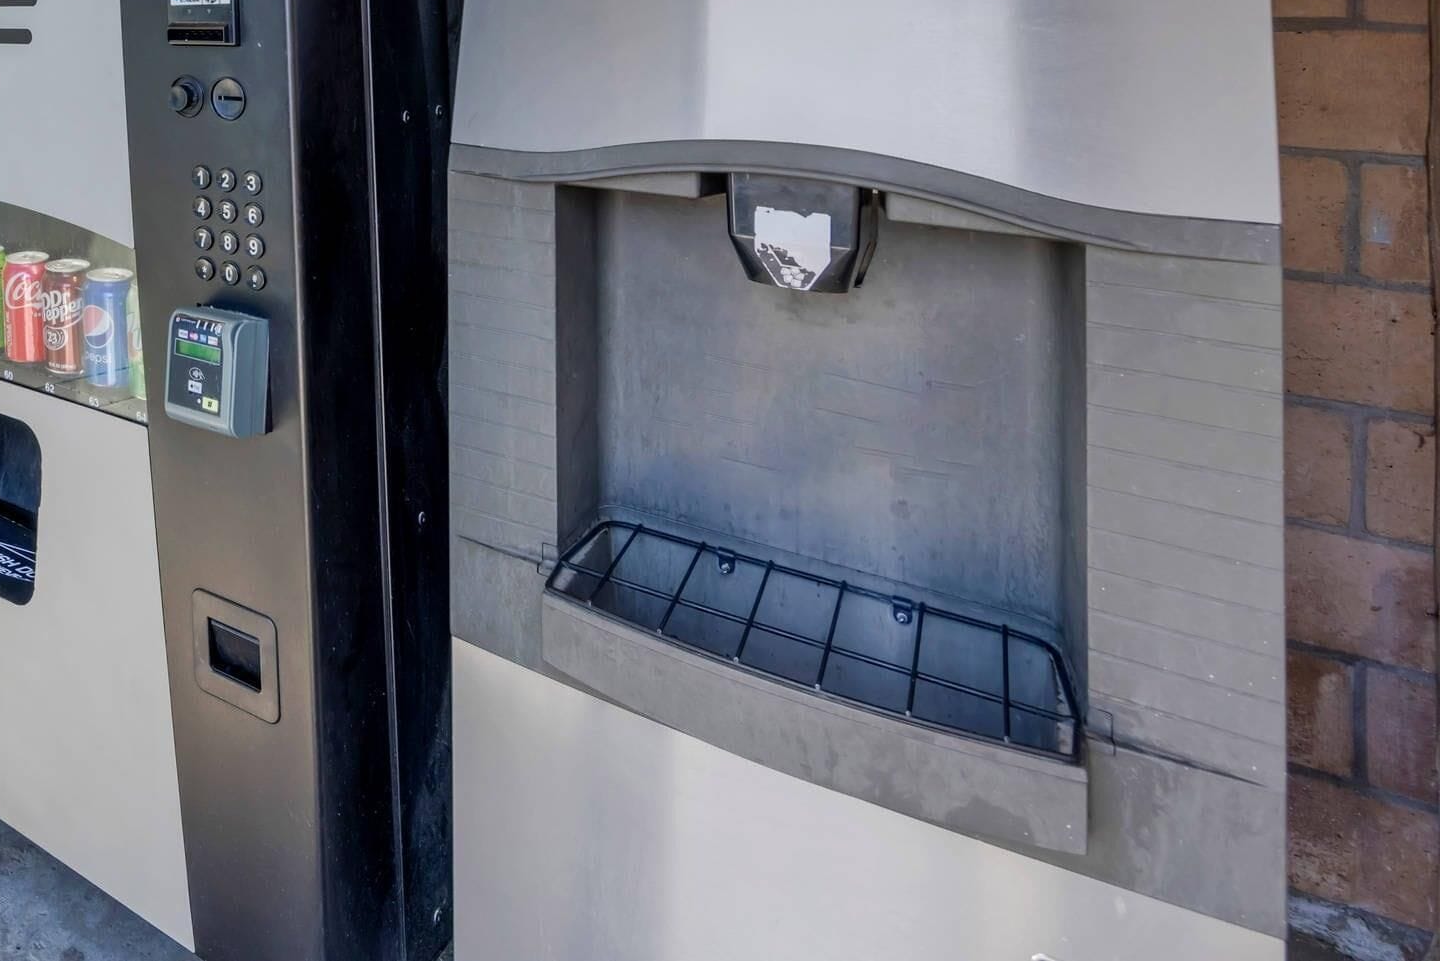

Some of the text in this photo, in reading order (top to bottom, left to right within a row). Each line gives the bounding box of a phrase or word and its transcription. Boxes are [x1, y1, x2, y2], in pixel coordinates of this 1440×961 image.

[196, 169, 256, 192] 1 2 3
[197, 200, 257, 224] 4 5 6
[198, 232, 258, 256] 7 8 9
[225, 265, 233, 282] 0
[3, 370, 14, 381] 60
[44, 382, 55, 394] 62
[88, 396, 100, 408] 63
